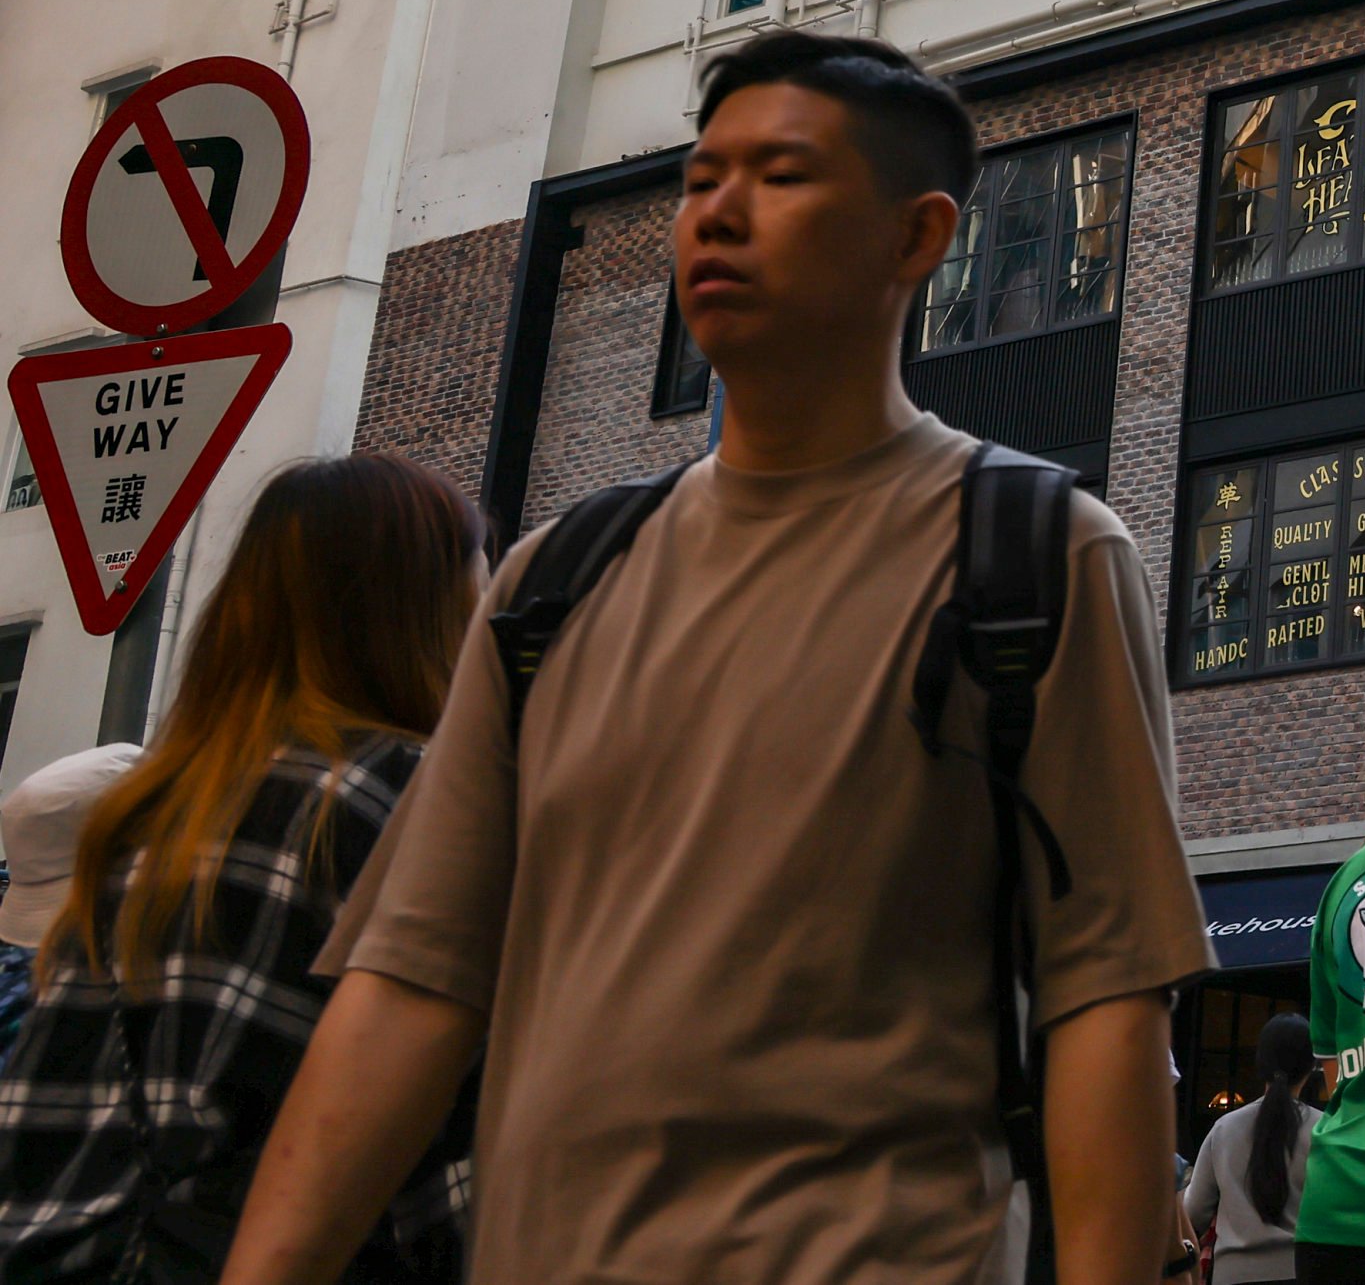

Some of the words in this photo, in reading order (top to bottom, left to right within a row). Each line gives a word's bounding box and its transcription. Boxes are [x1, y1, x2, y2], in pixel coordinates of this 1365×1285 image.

[95, 373, 185, 415] GIVE
[94, 417, 179, 458] WAY
[101, 474, 147, 523] 讓
[1273, 520, 1332, 549] QUALITY
[105, 551, 132, 564] BEAT
[1215, 526, 1232, 618] REPAIR
